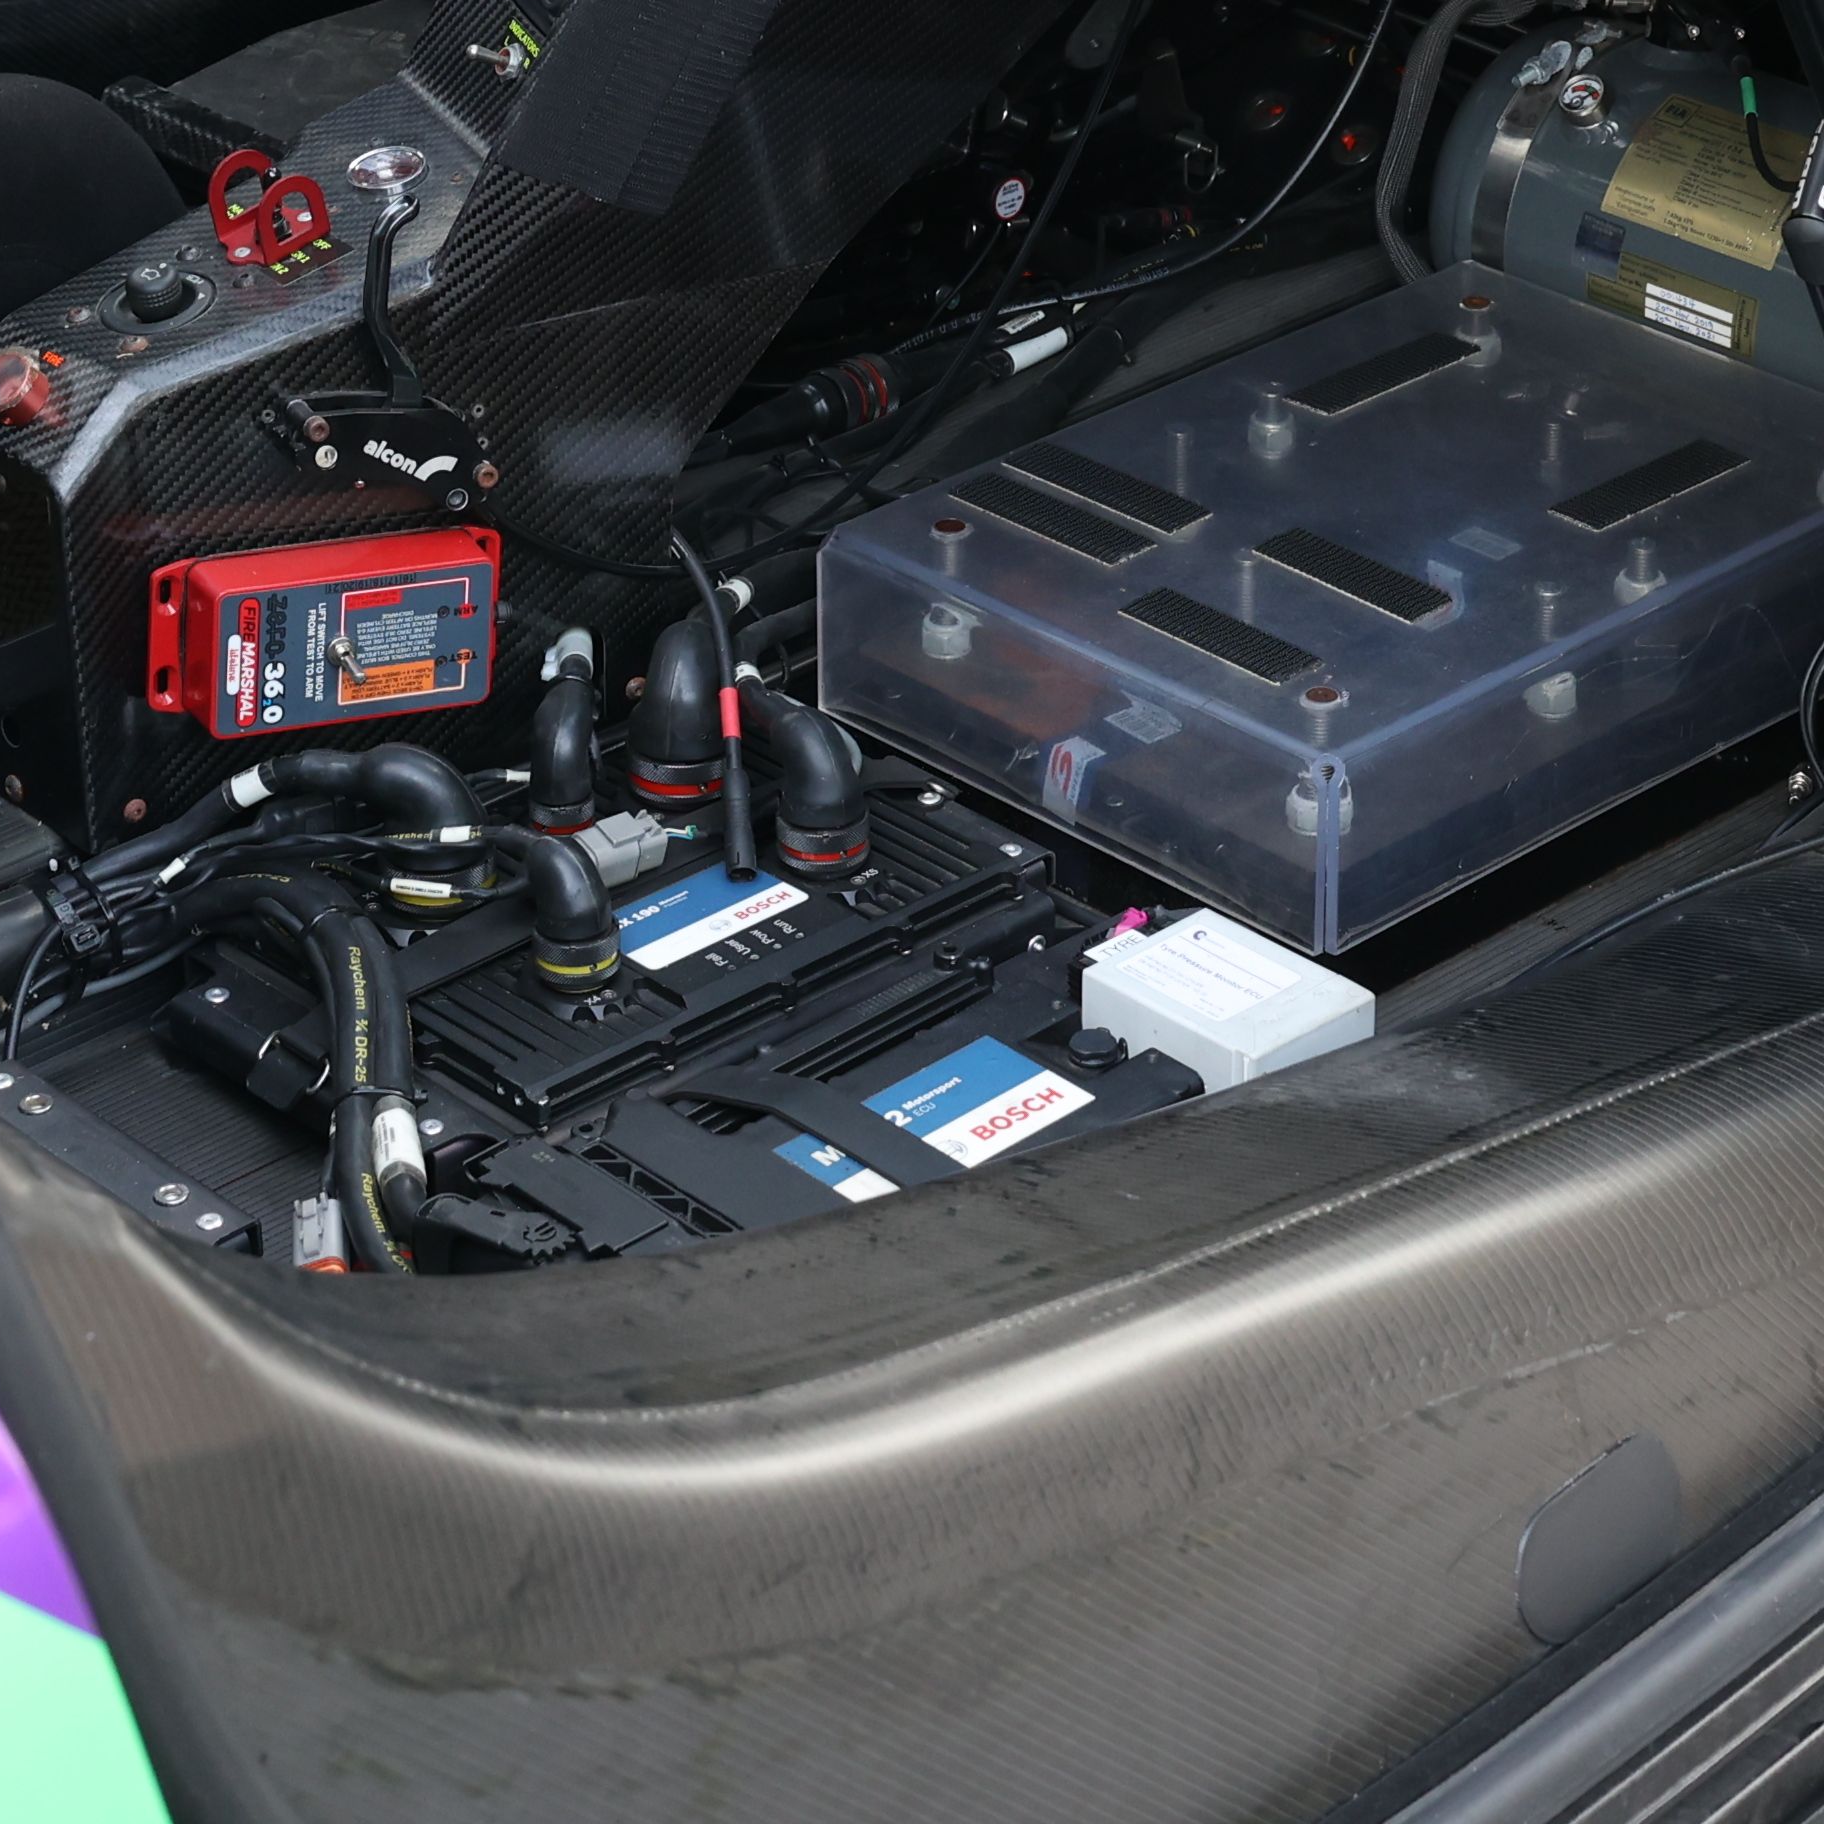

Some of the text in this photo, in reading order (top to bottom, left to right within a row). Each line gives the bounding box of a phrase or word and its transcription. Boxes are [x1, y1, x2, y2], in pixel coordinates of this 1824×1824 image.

[509, 19, 541, 58] INDICATORS
[42, 350, 65, 368] FIRE
[363, 438, 418, 474] alcon
[454, 604, 479, 618] ARM
[305, 609, 316, 698] FROM TEST TO ARM
[314, 603, 327, 702] LIFT SWITCH TO MOVE
[447, 650, 478, 663] TEST
[632, 905, 661, 922] 190
[734, 890, 792, 920] BOSCH
[749, 929, 774, 945] Pow
[773, 918, 797, 934] Run
[724, 939, 752, 956] User
[1100, 933, 1144, 957] TYRE
[705, 952, 728, 967] Fail
[1179, 953, 1214, 975] Pressure
[1214, 971, 1245, 990] Monitor
[1244, 988, 1264, 1000] ECU
[347, 945, 369, 1083] Raychem DR-25
[902, 1076, 962, 1112] Motorsport
[912, 1101, 937, 1118] ECU
[969, 1087, 1065, 1141] BOSCH
[360, 1171, 386, 1233] Raychem
